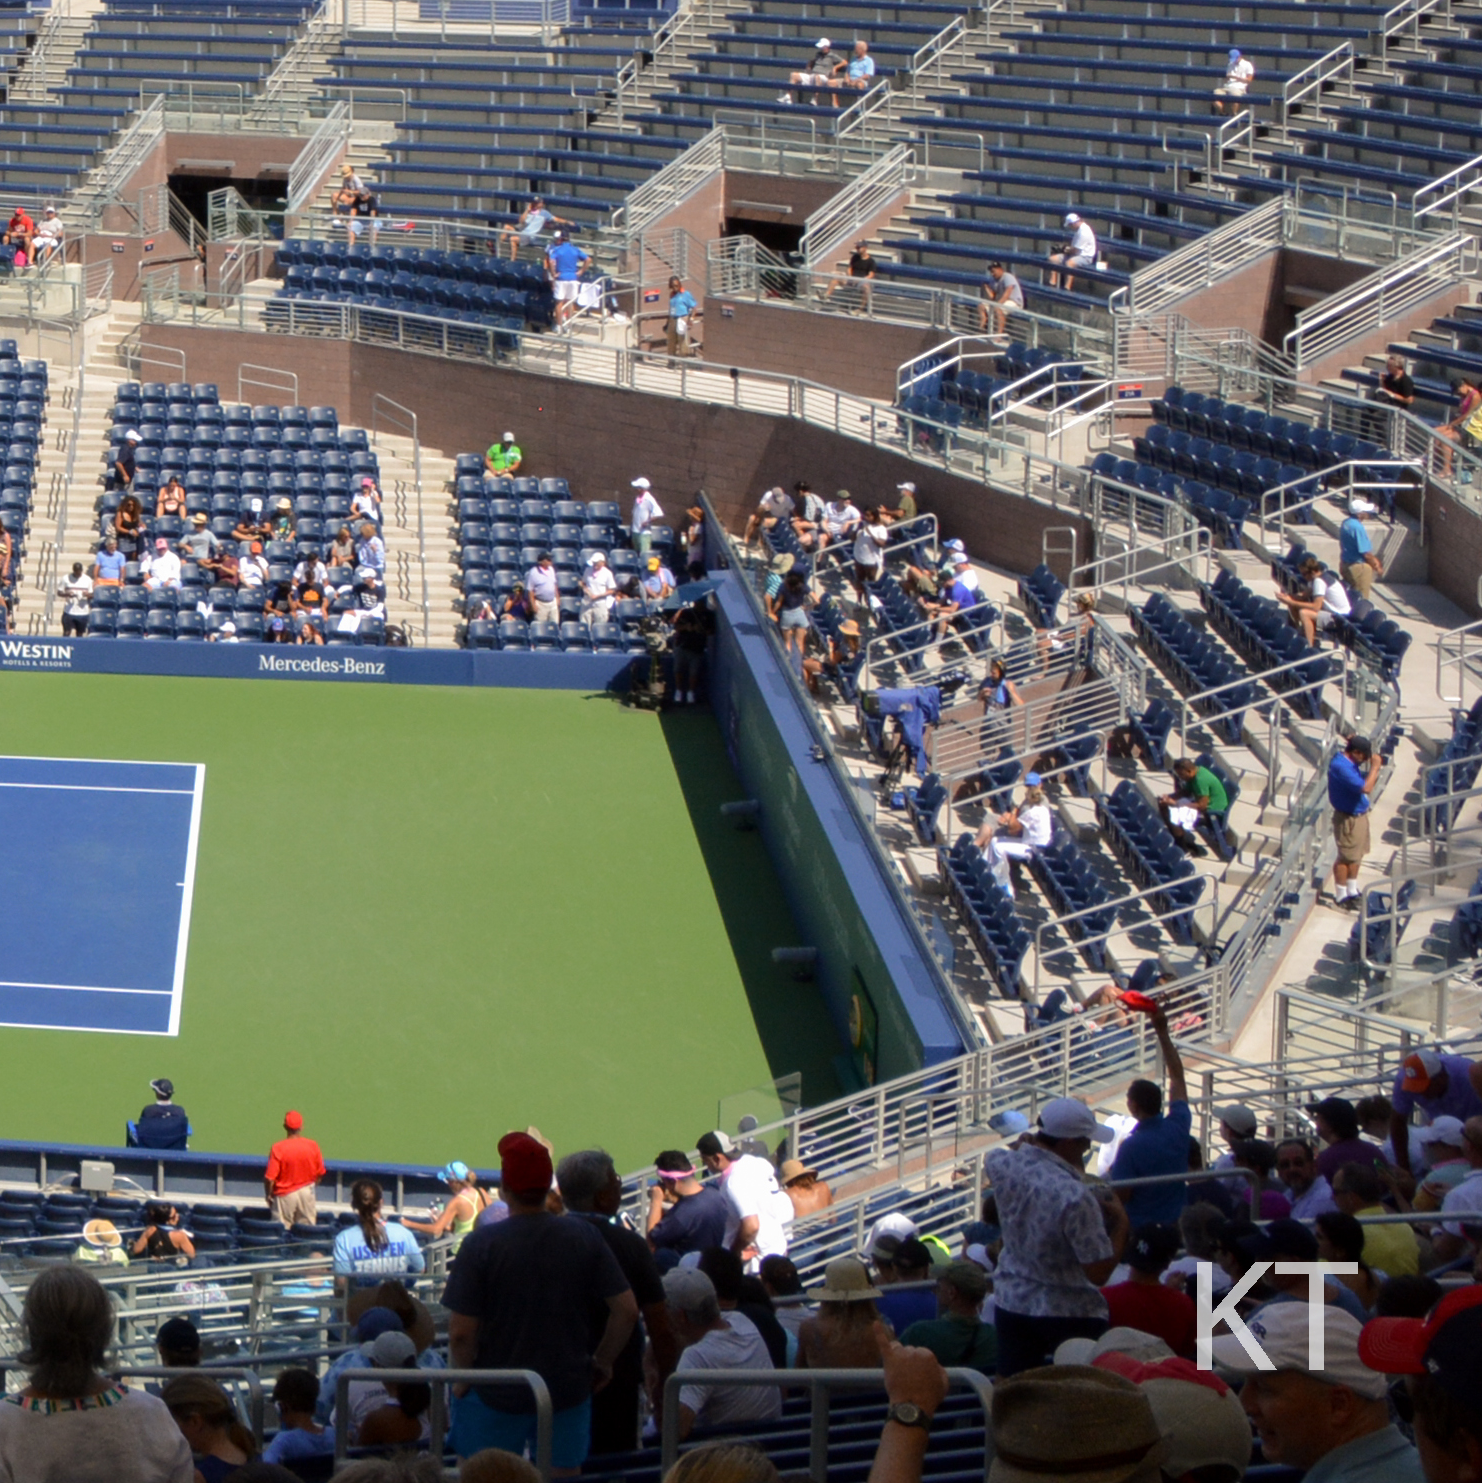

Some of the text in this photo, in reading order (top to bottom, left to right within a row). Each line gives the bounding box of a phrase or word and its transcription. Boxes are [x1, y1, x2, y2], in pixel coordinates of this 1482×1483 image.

[0, 640, 71, 660] WESTIN
[2, 659, 31, 667] HOTELS
[39, 660, 72, 668] RESORTS
[258, 654, 386, 676] Mercedes-Benz
[354, 1255, 407, 1273] TENNIS
